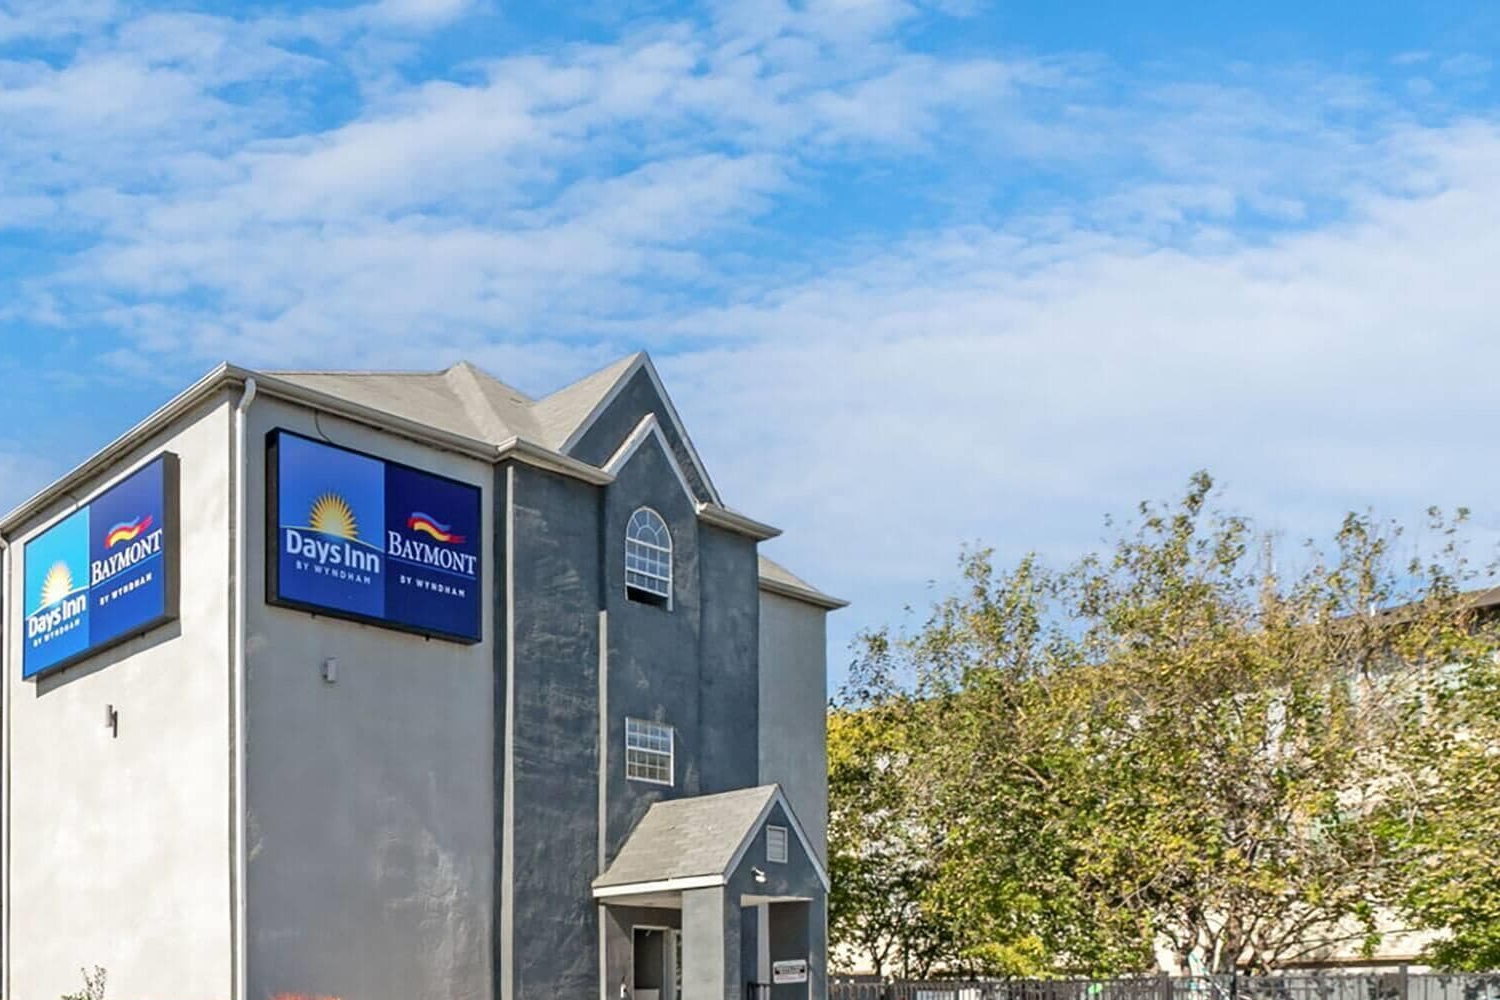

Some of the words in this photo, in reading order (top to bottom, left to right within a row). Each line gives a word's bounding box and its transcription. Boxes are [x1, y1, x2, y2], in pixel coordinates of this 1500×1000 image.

[91, 529, 163, 586] BAYMONT
[286, 529, 342, 564] Days
[345, 543, 380, 573] Inn
[296, 560, 309, 571] BY
[314, 565, 371, 584] WYNDHAM
[388, 530, 477, 575] BAYMONT
[400, 575, 412, 585] BY
[416, 579, 465, 597] WYNDHAM
[28, 607, 61, 638] Days
[63, 594, 87, 620] Inn
